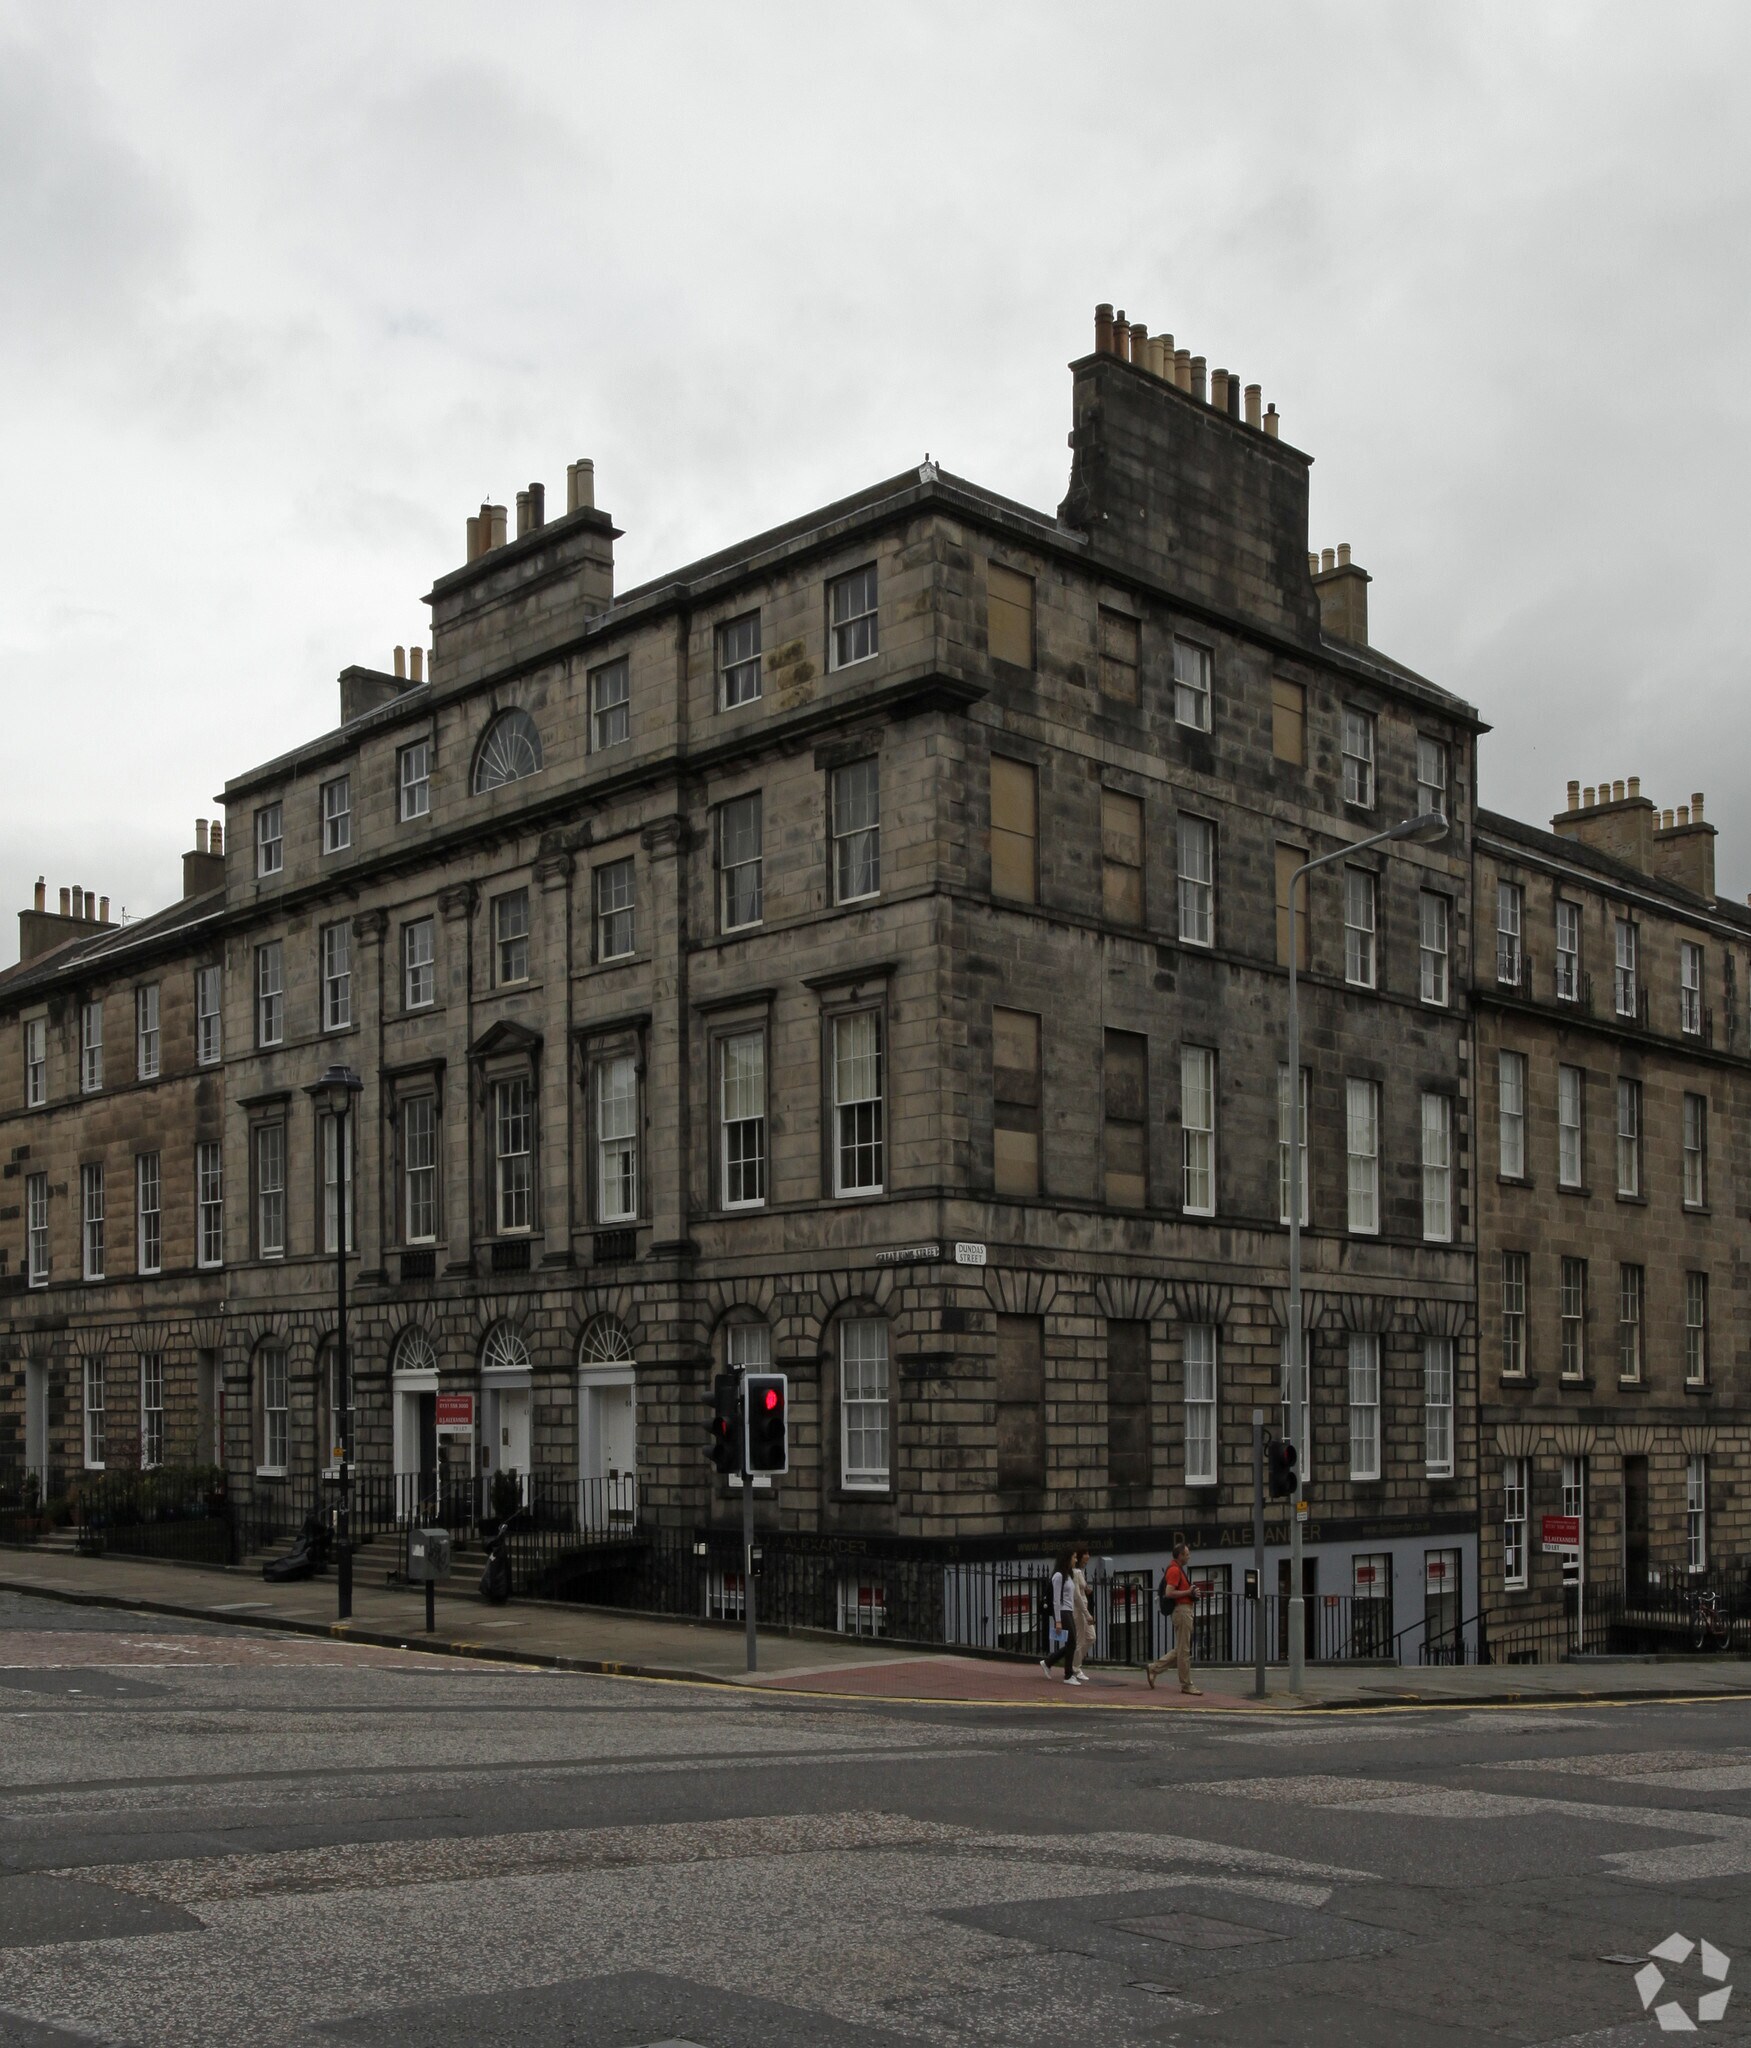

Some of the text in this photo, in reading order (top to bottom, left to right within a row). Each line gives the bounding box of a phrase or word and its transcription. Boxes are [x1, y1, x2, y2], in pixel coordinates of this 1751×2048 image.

[916, 1247, 938, 1258] STREET
[958, 1244, 984, 1254] DUNDAS
[959, 1253, 983, 1263] STREET
[1220, 1524, 1321, 1545] ALEANER
[783, 1537, 867, 1553] ALEXANDER
[1017, 1537, 1114, 1552] www.djalex.co.uk
